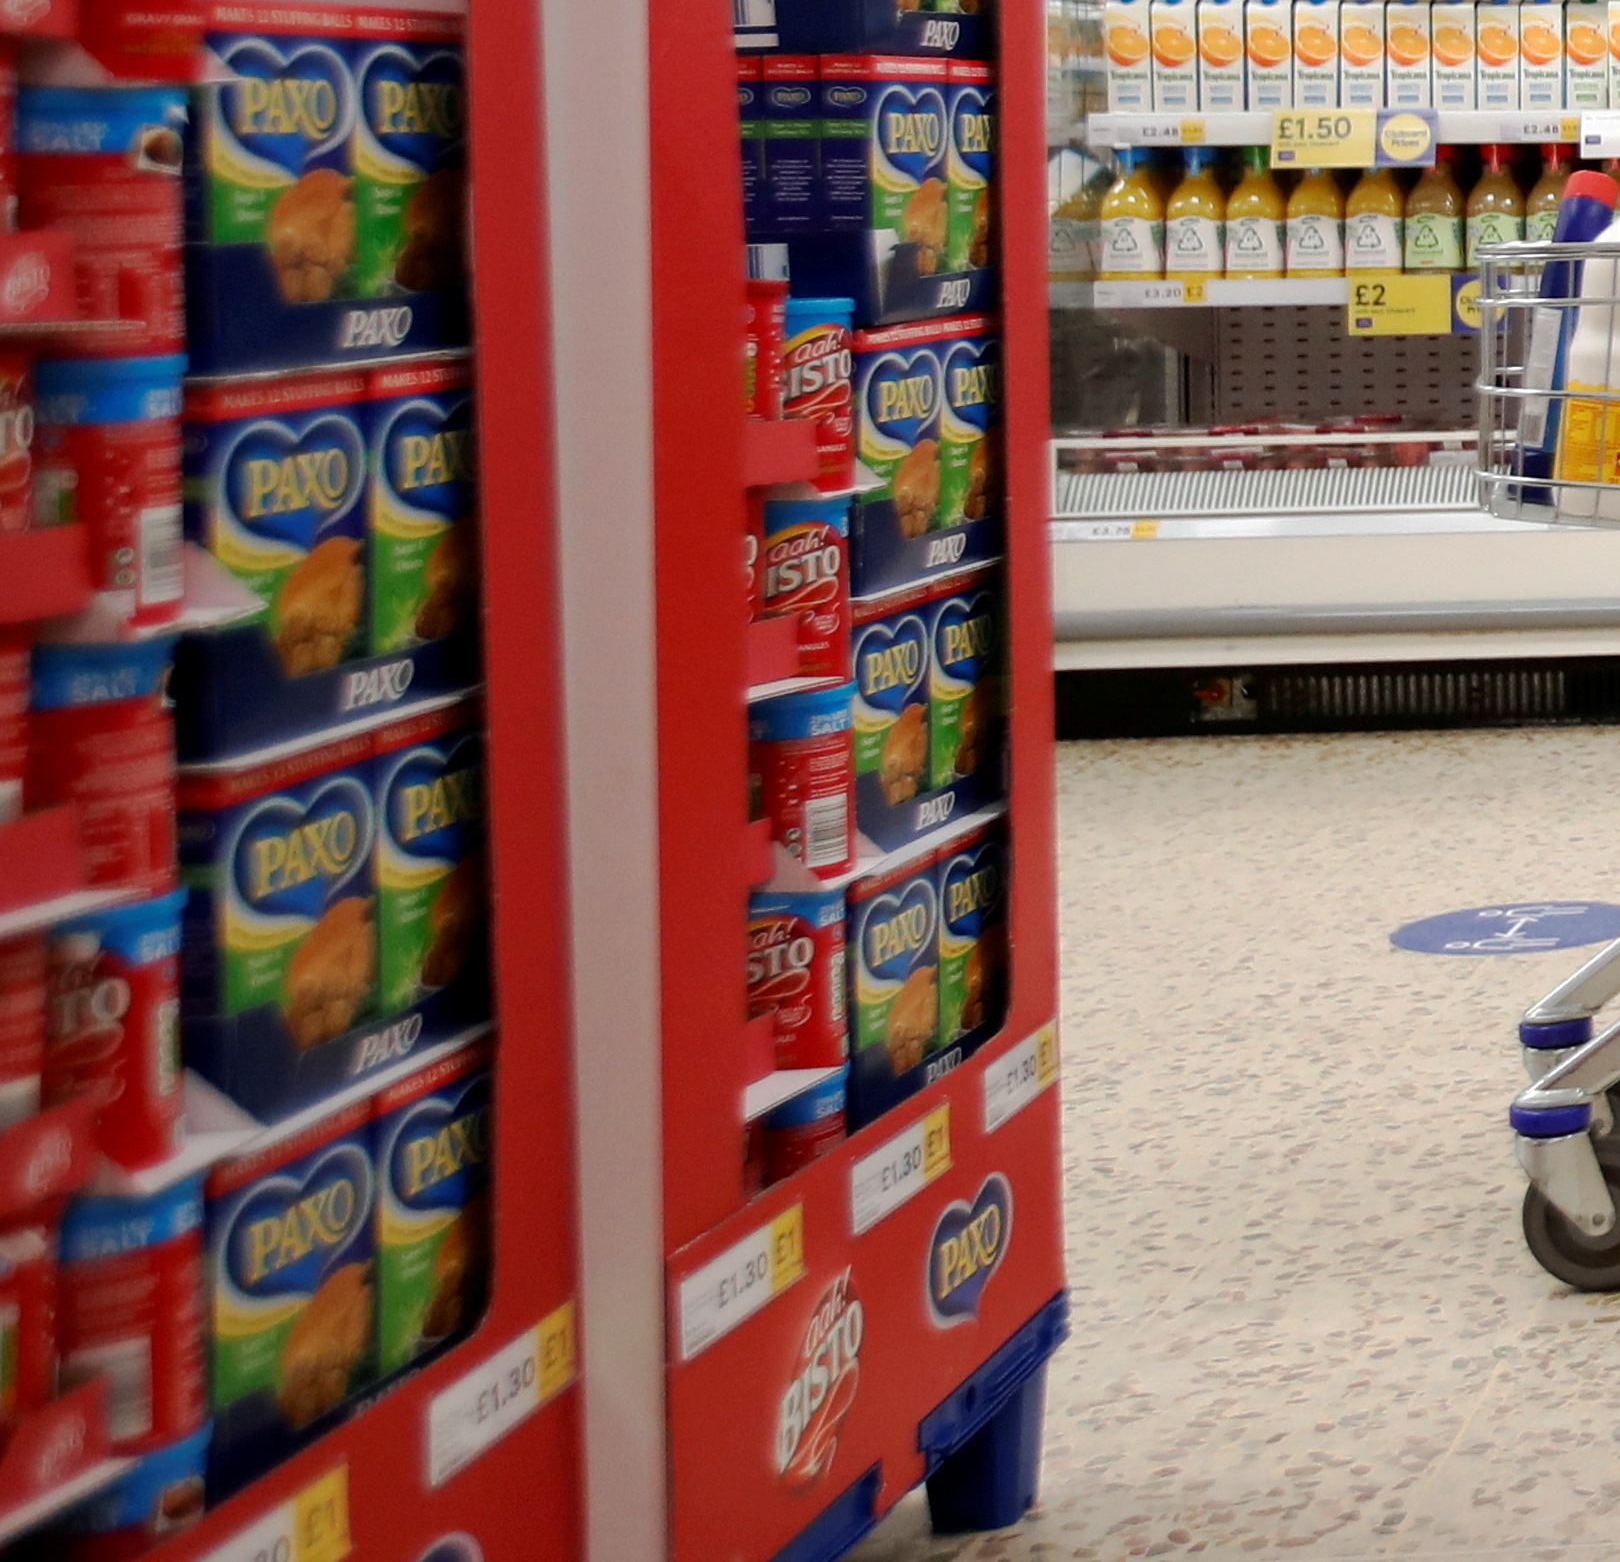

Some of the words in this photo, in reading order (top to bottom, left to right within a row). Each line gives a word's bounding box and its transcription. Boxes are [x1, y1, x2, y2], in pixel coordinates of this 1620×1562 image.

[1111, 70, 1149, 82] Tropicana
[1251, 70, 1288, 82] Tropicana
[1390, 69, 1427, 81] Tropicana
[1523, 68, 1559, 80] Tropicana
[241, 77, 337, 139] PAXO
[1142, 126, 1179, 138] £2.48
[1278, 116, 1353, 140] £1.50
[1522, 124, 1560, 136] £2.48
[887, 112, 940, 155] PAXO
[1144, 287, 1182, 300] £3.20
[1354, 284, 1387, 307] £2
[794, 326, 845, 363] aah!
[878, 374, 934, 424] PAXO
[247, 446, 349, 518] PAXO
[769, 524, 829, 564] aah!
[866, 639, 919, 697] PAXO
[810, 718, 849, 737] SALT
[256, 809, 357, 896] PAXO
[872, 906, 931, 966] PAXO
[1006, 1053, 1037, 1094] £1.30
[1040, 1039, 1054, 1071] £1
[881, 1148, 923, 1193] £1.30
[926, 1128, 945, 1160] £1
[249, 1178, 354, 1287] PAXO
[937, 1202, 1002, 1301] PAXO
[719, 1254, 769, 1310] £1.30
[775, 1230, 797, 1268] £1
[804, 1266, 850, 1348] aah!
[476, 1360, 537, 1424] £1.30
[541, 1327, 569, 1371] £1
[776, 1297, 863, 1466] BISTO
[304, 1494, 338, 1542] £1
